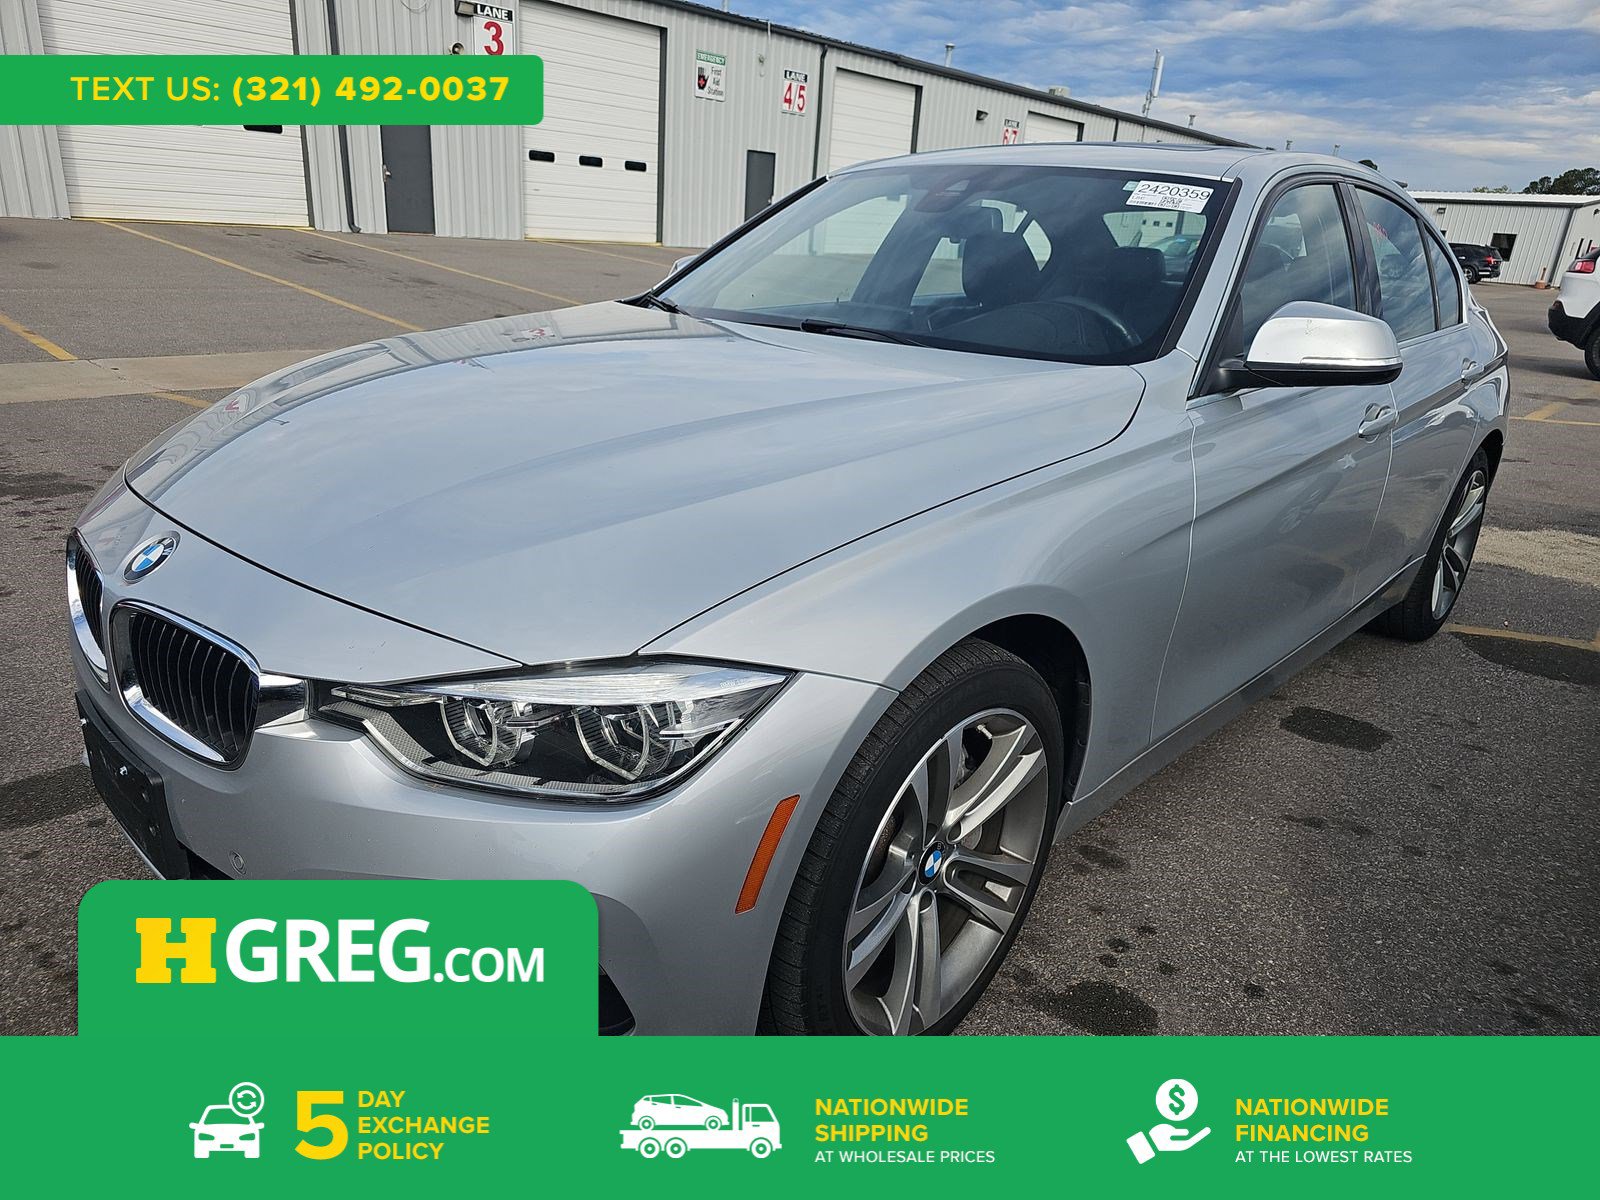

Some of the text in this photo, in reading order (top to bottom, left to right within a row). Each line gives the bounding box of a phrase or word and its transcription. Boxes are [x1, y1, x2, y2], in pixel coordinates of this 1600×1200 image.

[477, 4, 508, 20] LANE
[483, 20, 504, 55] 3
[786, 71, 805, 82] LANE
[1138, 183, 1211, 200] 2420359
